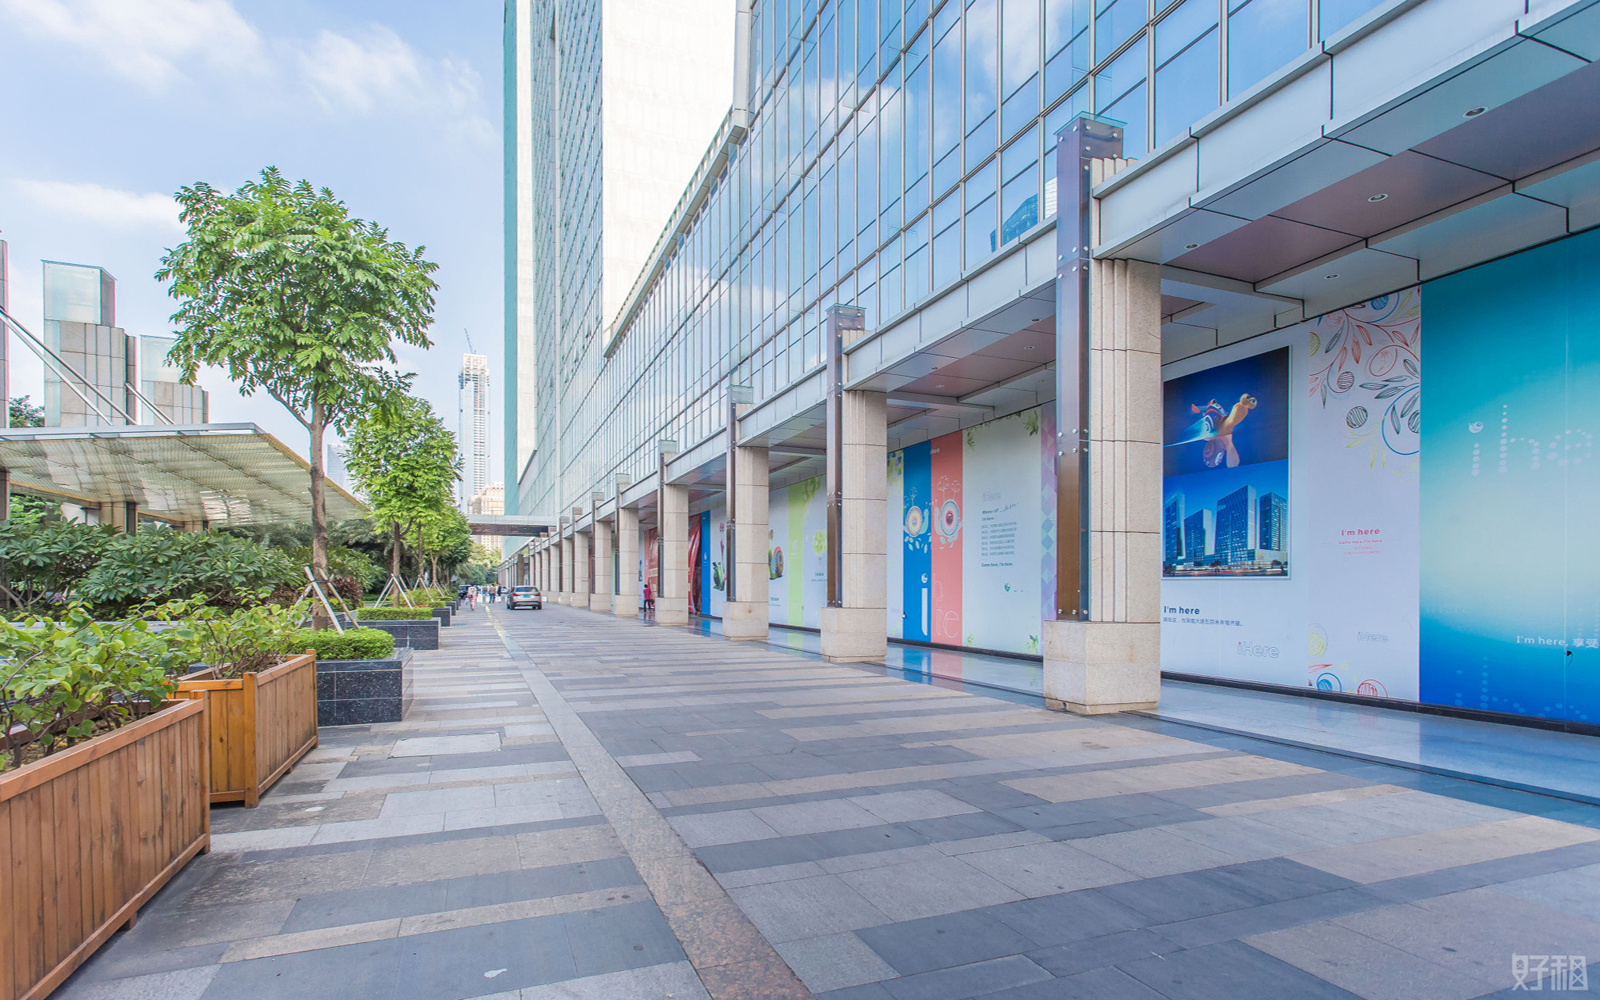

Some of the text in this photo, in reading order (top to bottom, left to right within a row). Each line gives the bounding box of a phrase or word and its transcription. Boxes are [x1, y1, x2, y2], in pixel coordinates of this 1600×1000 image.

[1163, 605, 1200, 615] I'm here
[1516, 635, 1535, 644] I'm
[1538, 636, 1569, 647] here,
[1237, 640, 1280, 659] iHere
